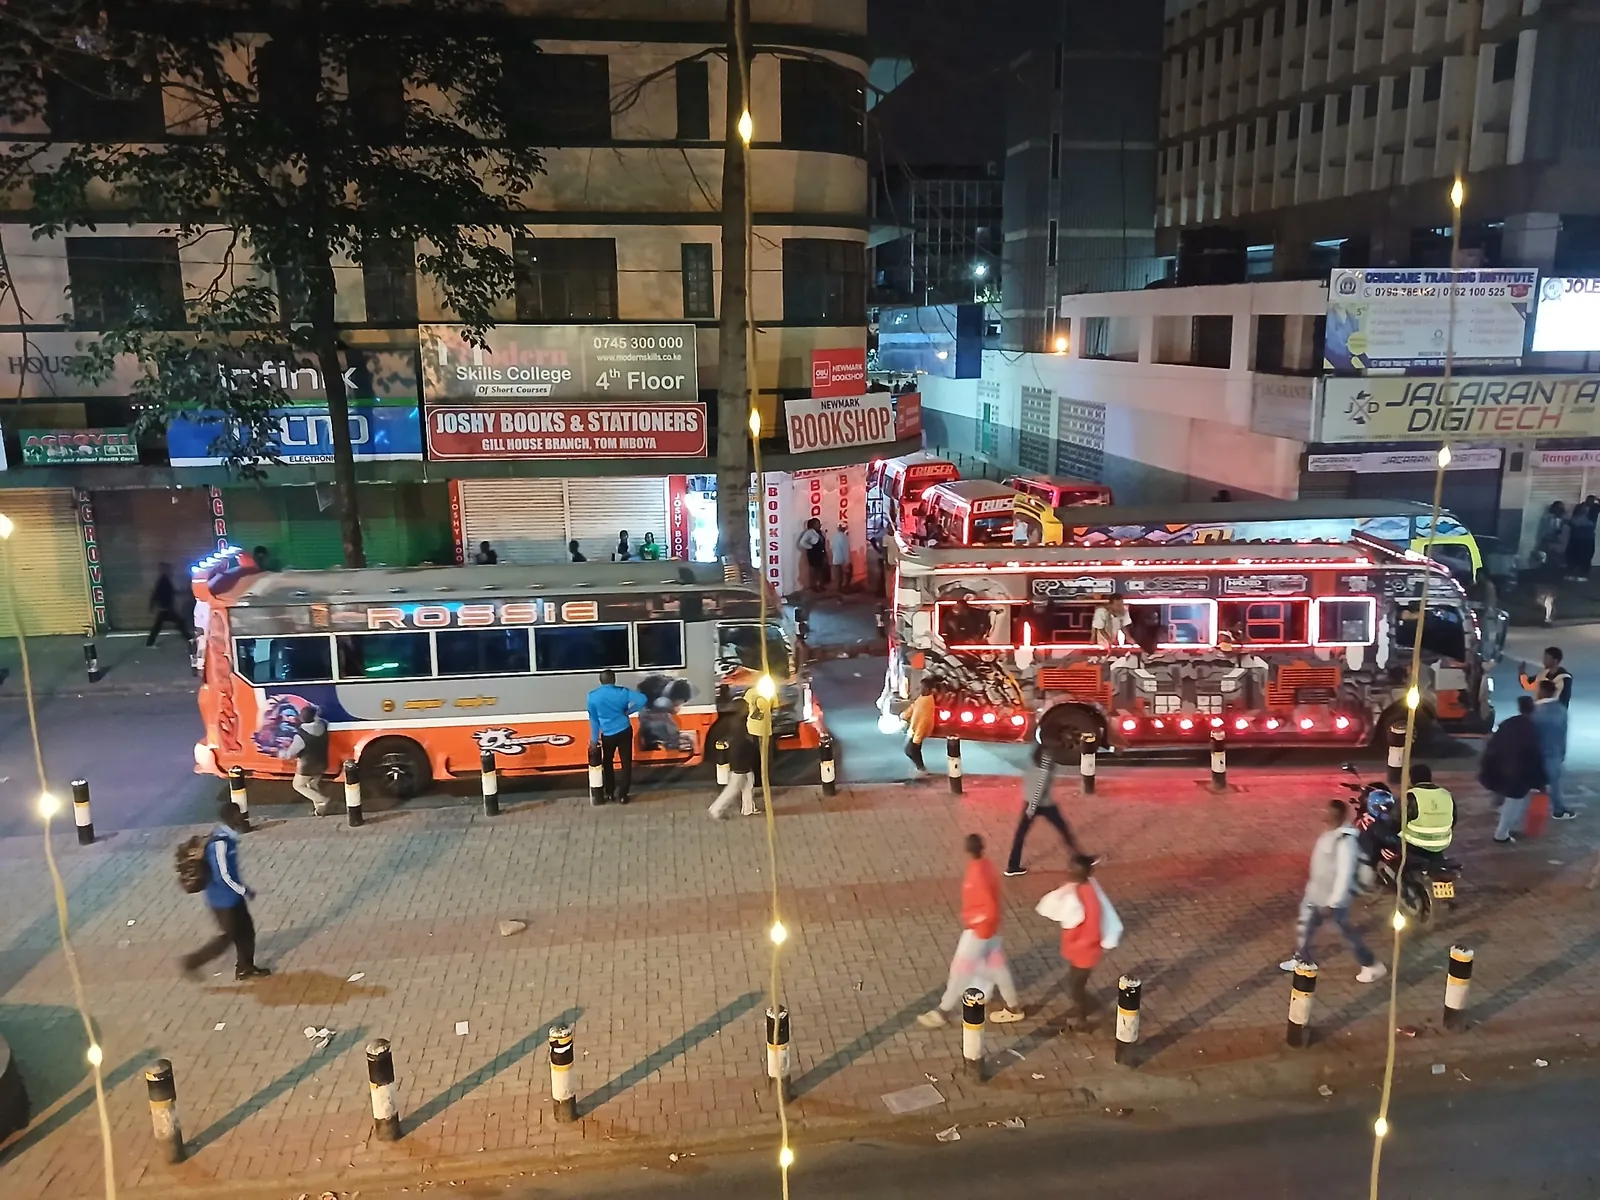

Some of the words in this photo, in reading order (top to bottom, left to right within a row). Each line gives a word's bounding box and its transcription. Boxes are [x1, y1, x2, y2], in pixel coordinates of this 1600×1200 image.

[1424, 272, 1475, 284] TRAINING
[1478, 272, 1534, 284] INSTITUTE
[1469, 287, 1485, 297] 100
[1488, 287, 1505, 297] 525
[593, 337, 627, 350] 0745
[630, 337, 655, 349] 300
[657, 336, 684, 349] 000
[596, 352, 682, 362] www.modernskills.co.ke
[8, 356, 76, 374] HOUS
[831, 363, 863, 372] NEWMARK
[217, 360, 360, 390] Infinx
[456, 366, 502, 381] Skills
[506, 366, 572, 383] College
[595, 368, 621, 391] 4th
[627, 370, 685, 391] Floor
[831, 373, 864, 382] BOOKSHOP
[478, 385, 489, 395] Of
[491, 386, 514, 394] Short
[515, 385, 548, 394] Courses
[1385, 380, 1600, 408] JACARANTA
[820, 398, 860, 411] NEWMARK
[436, 412, 496, 434] JOSHY
[501, 412, 566, 433] BOOKS
[570, 415, 585, 433] &
[588, 411, 699, 433] STATIONERS
[1406, 407, 1564, 432] DIGITECH
[790, 406, 890, 450] BOOKSHOP
[25, 433, 129, 447] AGROVET
[481, 439, 506, 451] GILL
[507, 438, 543, 451] HOUSE
[545, 437, 593, 451] BRANCH,
[594, 437, 617, 450] TOM
[619, 437, 657, 449] MBOYA
[289, 455, 334, 464] ELECTRONI
[1381, 454, 1437, 465] JACARAN
[1542, 453, 1580, 466] Range
[909, 464, 954, 478] CRUISER
[810, 479, 821, 517] BOO
[973, 497, 1014, 514] CRUIS
[451, 495, 461, 535] JOSHY
[673, 492, 683, 528] JOSHY
[767, 486, 780, 590] BOOKSHOP
[78, 490, 106, 625] AGROVET
